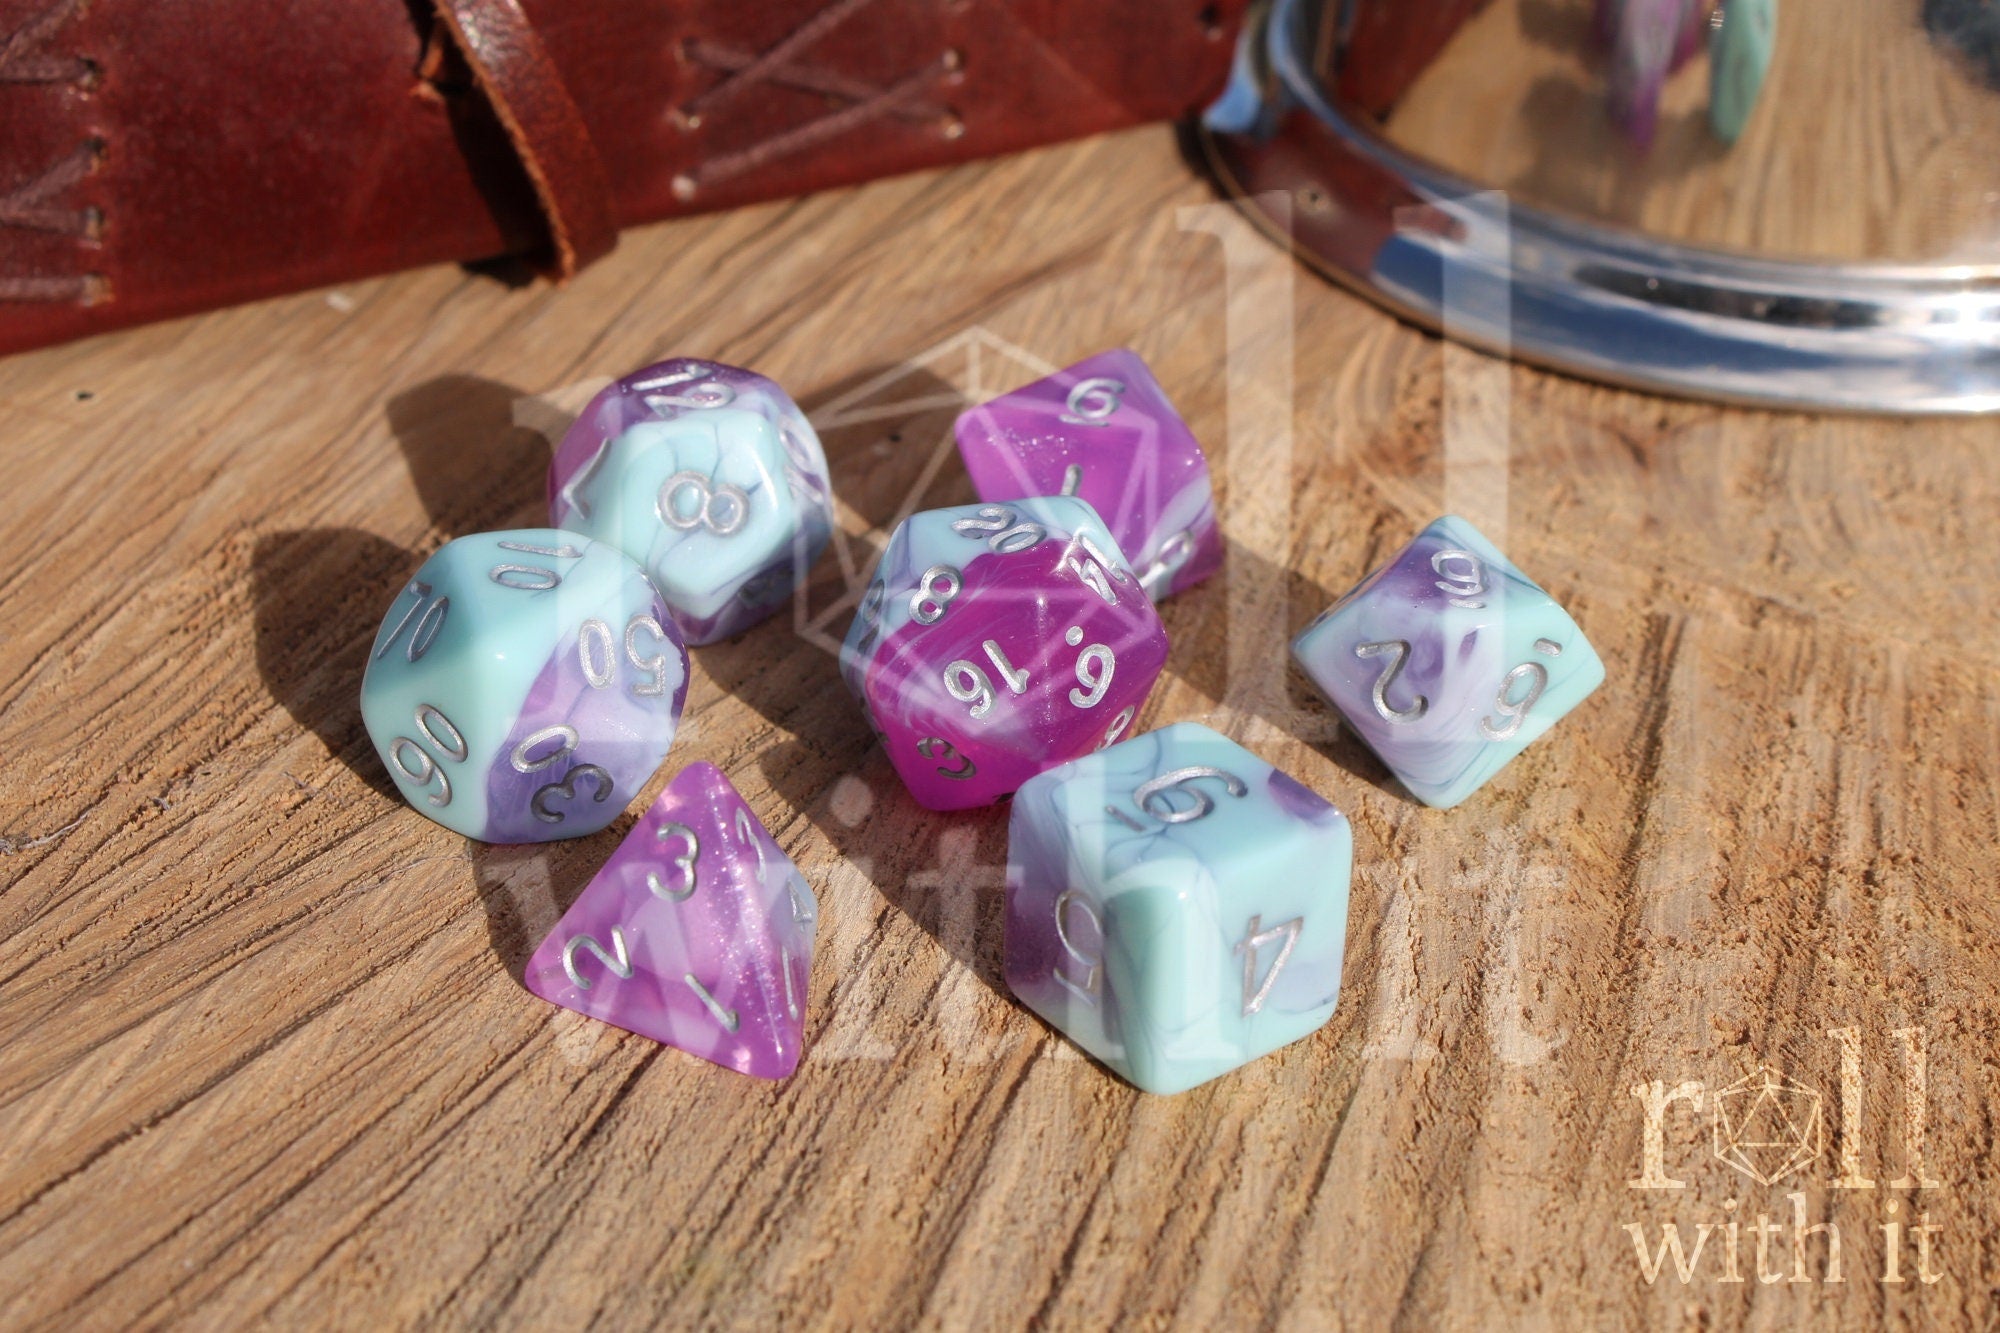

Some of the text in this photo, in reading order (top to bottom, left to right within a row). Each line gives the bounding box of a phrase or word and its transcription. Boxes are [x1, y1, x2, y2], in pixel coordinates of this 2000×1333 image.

[656, 469, 747, 537] 8
[950, 506, 1047, 553] 20
[376, 580, 450, 662] 70
[909, 564, 964, 625] 8
[578, 614, 667, 697] 50
[1355, 639, 1429, 725] 2
[388, 702, 469, 807] 90
[510, 723, 614, 824] 30
[916, 737, 977, 780] 3
[647, 821, 698, 902] 3
[562, 925, 635, 991] 2
[1232, 914, 1305, 1022] 4
[684, 972, 741, 1034] 1
